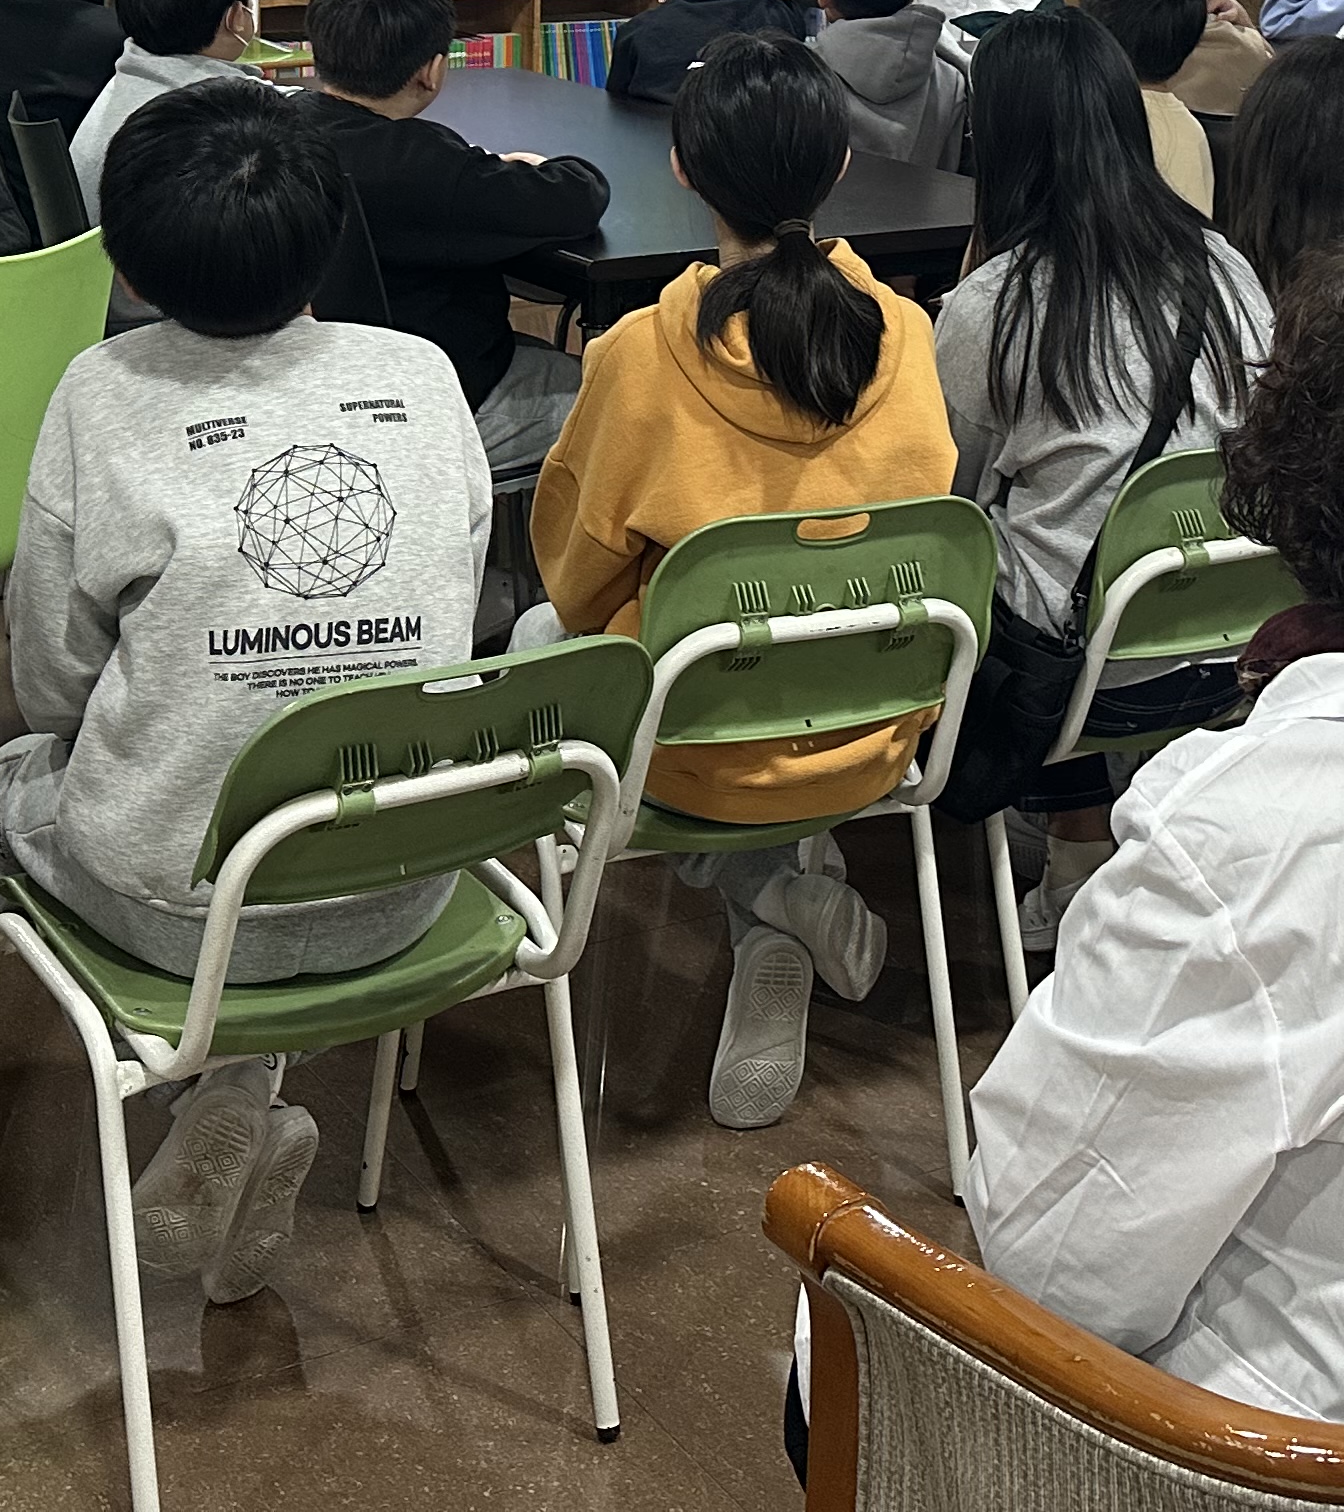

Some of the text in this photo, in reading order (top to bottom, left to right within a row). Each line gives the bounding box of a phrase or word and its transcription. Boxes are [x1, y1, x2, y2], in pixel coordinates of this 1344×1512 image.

[339, 399, 406, 413] SUPERNATURAL
[372, 412, 408, 423] POWERS
[186, 416, 248, 437] MULTIVERSE
[188, 438, 206, 452] NO.
[208, 616, 422, 657] LUMINOUS BEAM
[213, 658, 419, 682] THE BOY DISCOVERS HE HAS MAGICAL POWERS
[247, 679, 278, 691] THERE
[279, 678, 287, 687] IS
[289, 677, 304, 687] NO
[306, 675, 327, 686] ONE
[328, 674, 342, 684] TO
[275, 688, 300, 699] HOW
